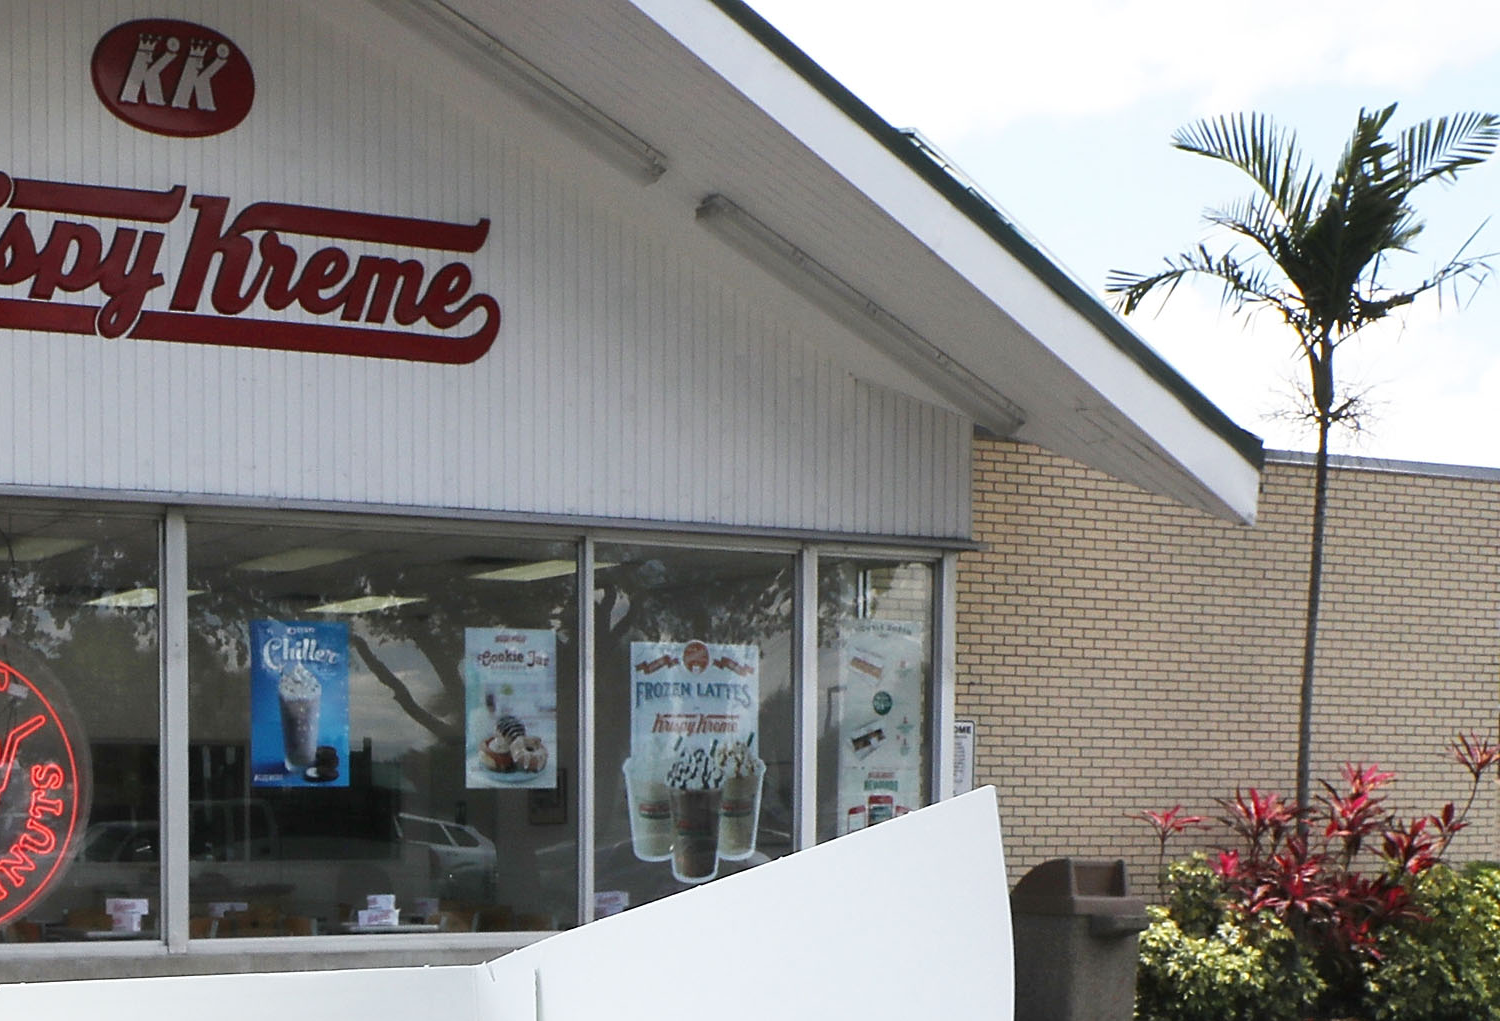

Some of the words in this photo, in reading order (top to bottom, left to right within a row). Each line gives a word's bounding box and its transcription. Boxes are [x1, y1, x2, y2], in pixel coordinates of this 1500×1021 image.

[169, 194, 501, 364] Kreme
[262, 637, 342, 674] Chiller
[476, 649, 525, 667] Cookie
[526, 650, 550, 667] Jar
[635, 682, 692, 708] FROZEN
[696, 682, 751, 708] LATTES
